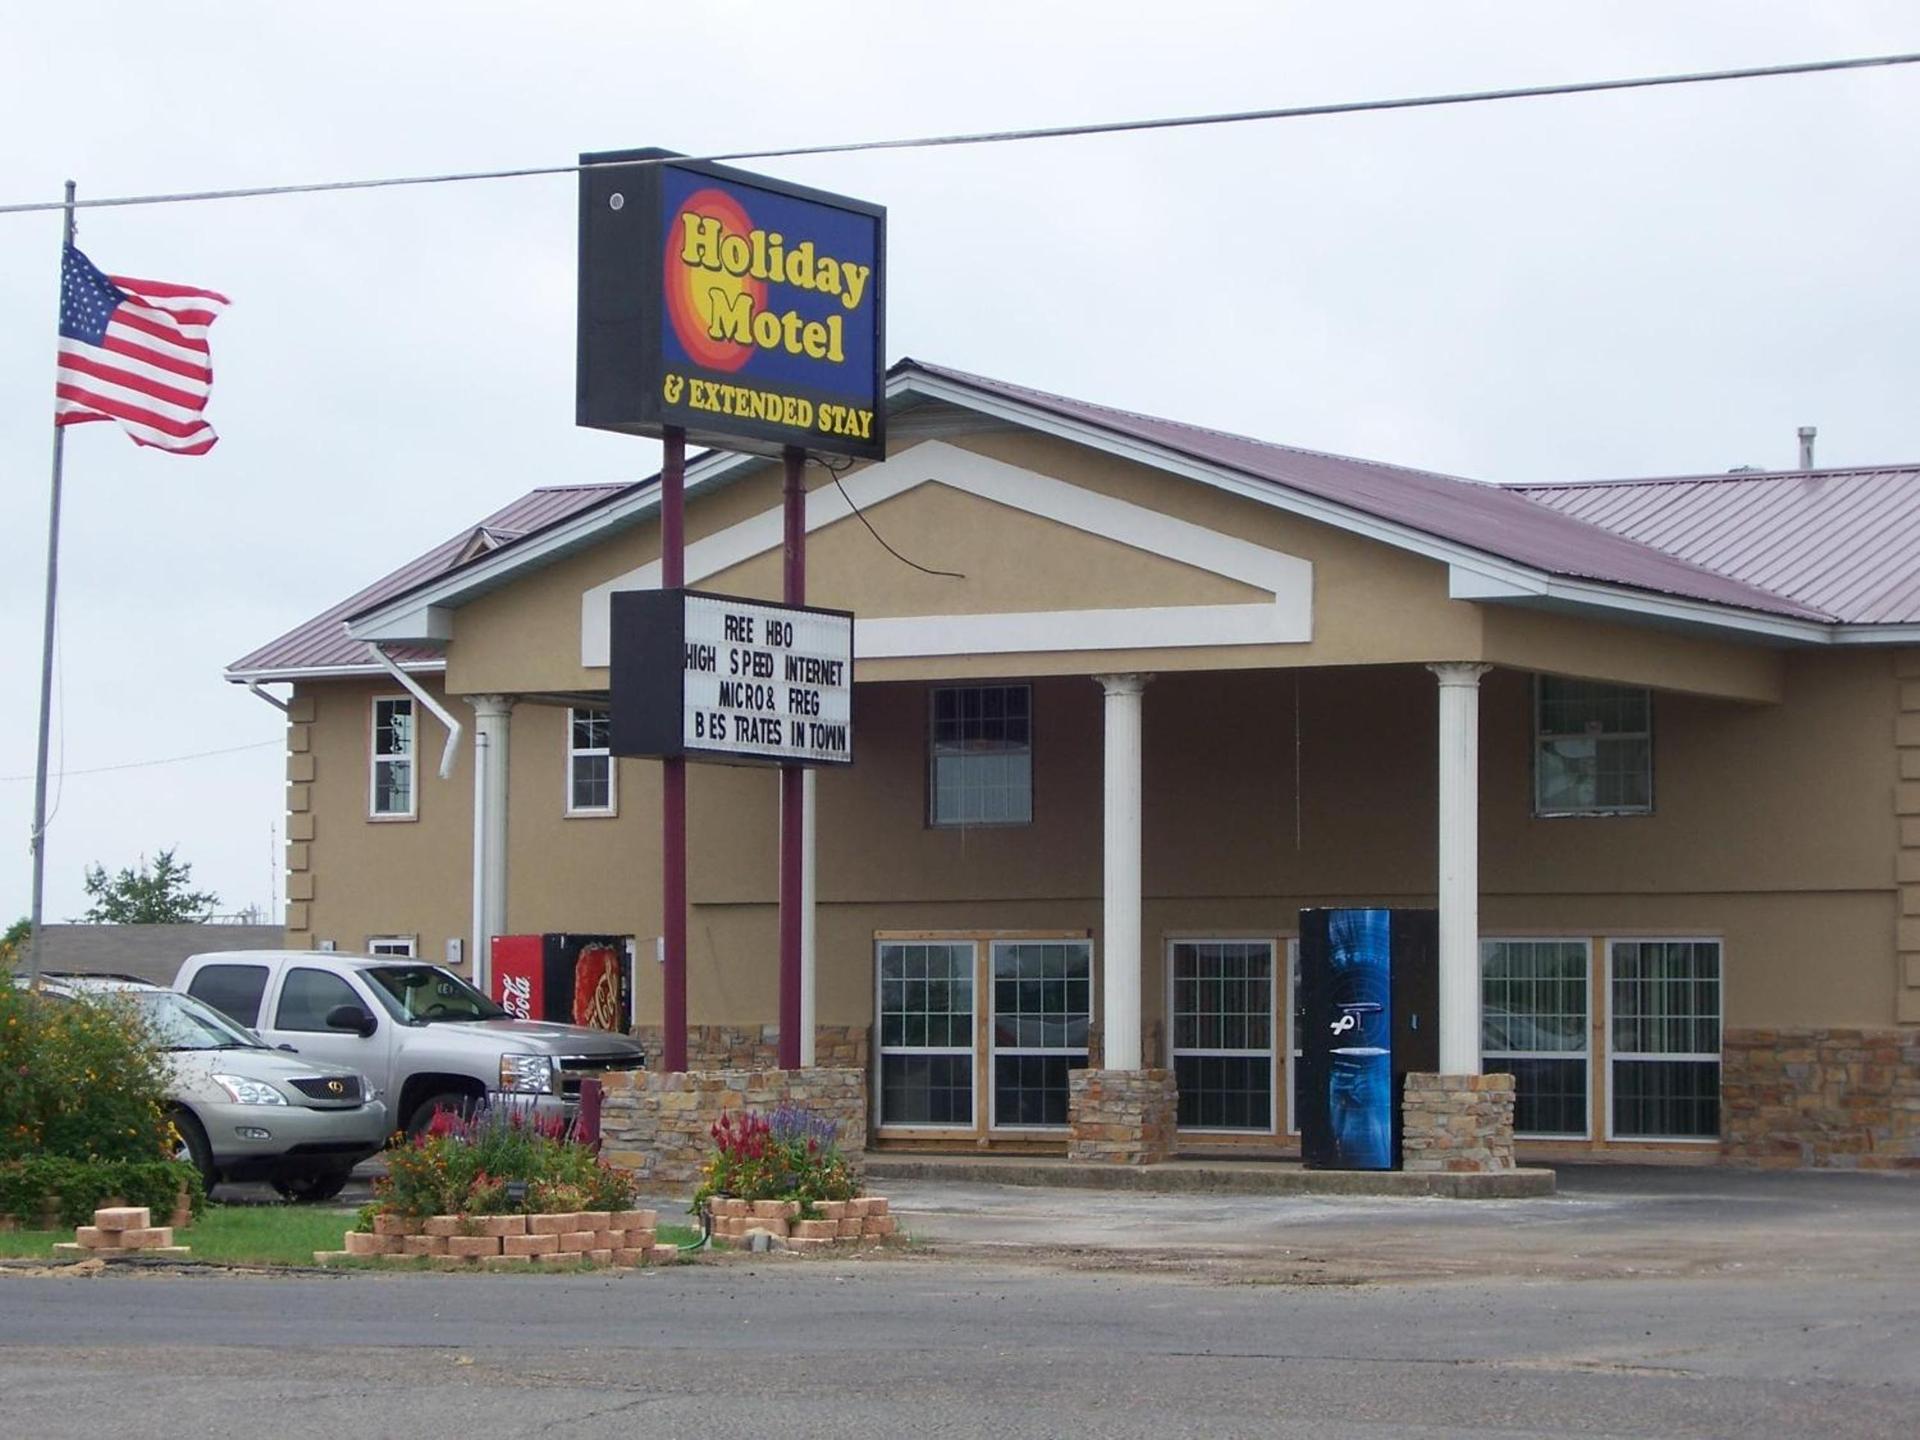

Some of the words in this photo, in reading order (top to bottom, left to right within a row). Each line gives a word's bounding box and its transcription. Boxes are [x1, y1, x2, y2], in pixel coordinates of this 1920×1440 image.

[682, 212, 869, 309] Holiday
[708, 287, 844, 362] Motel
[664, 374, 684, 404] &
[689, 379, 813, 429] EXTENDED
[818, 403, 873, 438] STAY
[725, 614, 753, 643] FREE
[766, 619, 793, 648] HBO
[685, 643, 716, 672] HIGH
[730, 648, 774, 678] SPEED
[785, 655, 843, 687] INTERNET
[791, 721, 805, 748] IN
[809, 723, 846, 751] TOWN
